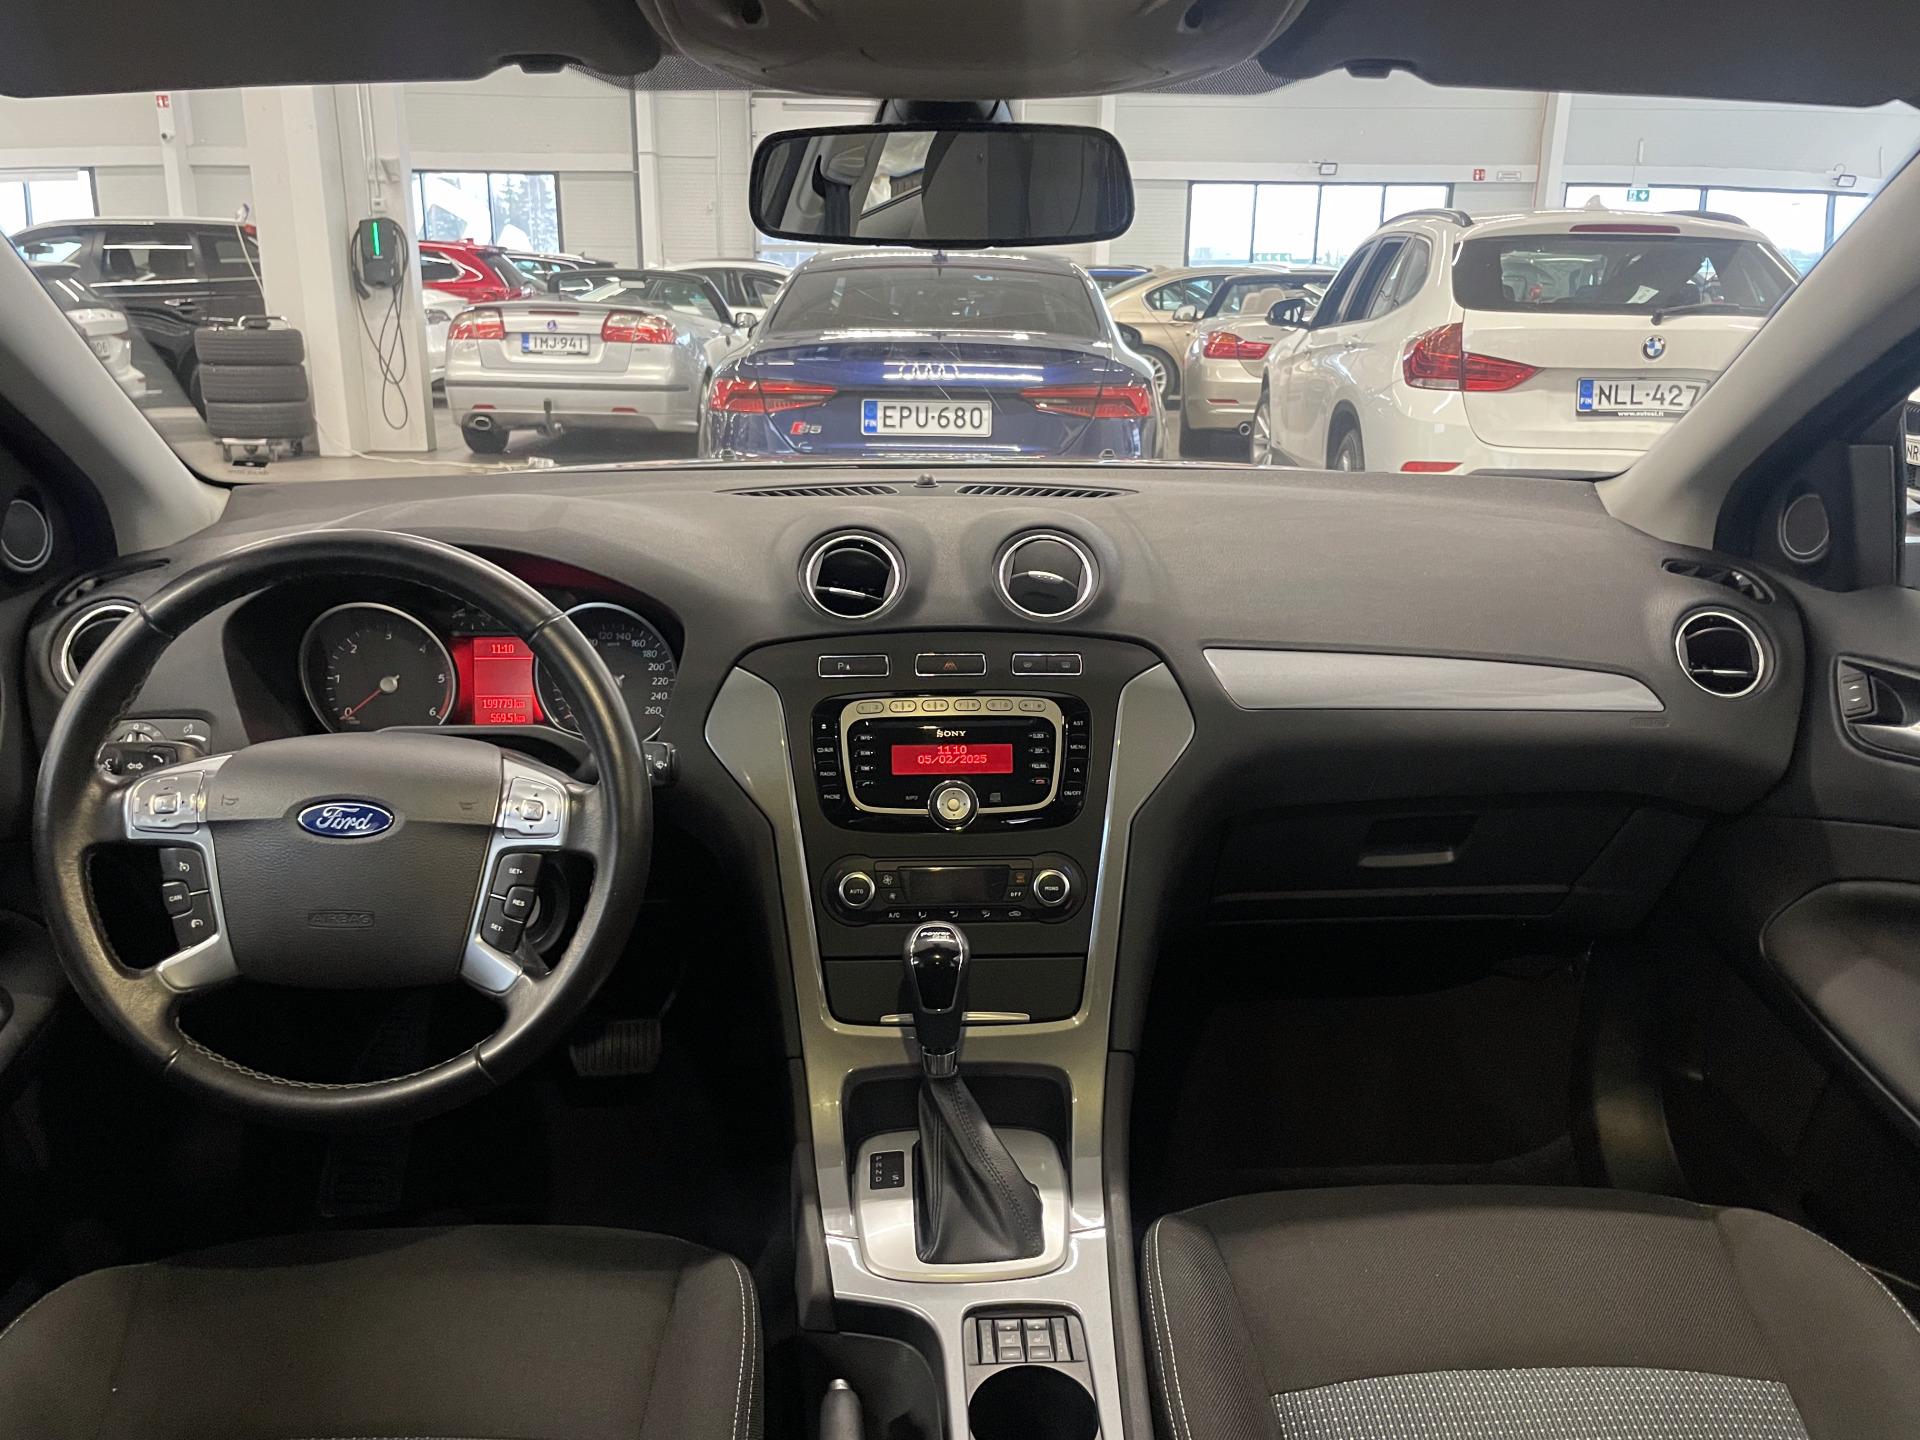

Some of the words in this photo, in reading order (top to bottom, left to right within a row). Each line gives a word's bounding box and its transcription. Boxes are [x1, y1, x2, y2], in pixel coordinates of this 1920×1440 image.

[647, 663, 665, 671] 200
[651, 677, 669, 686] 220
[650, 692, 668, 700] 240
[644, 706, 662, 715] 260
[936, 729, 967, 737] SONY
[917, 755, 988, 764] 05/02/2025
[315, 806, 374, 830] Ford
[168, 894, 183, 903] CAN
[512, 898, 526, 907] RES
[312, 913, 371, 924] AIRBAG
